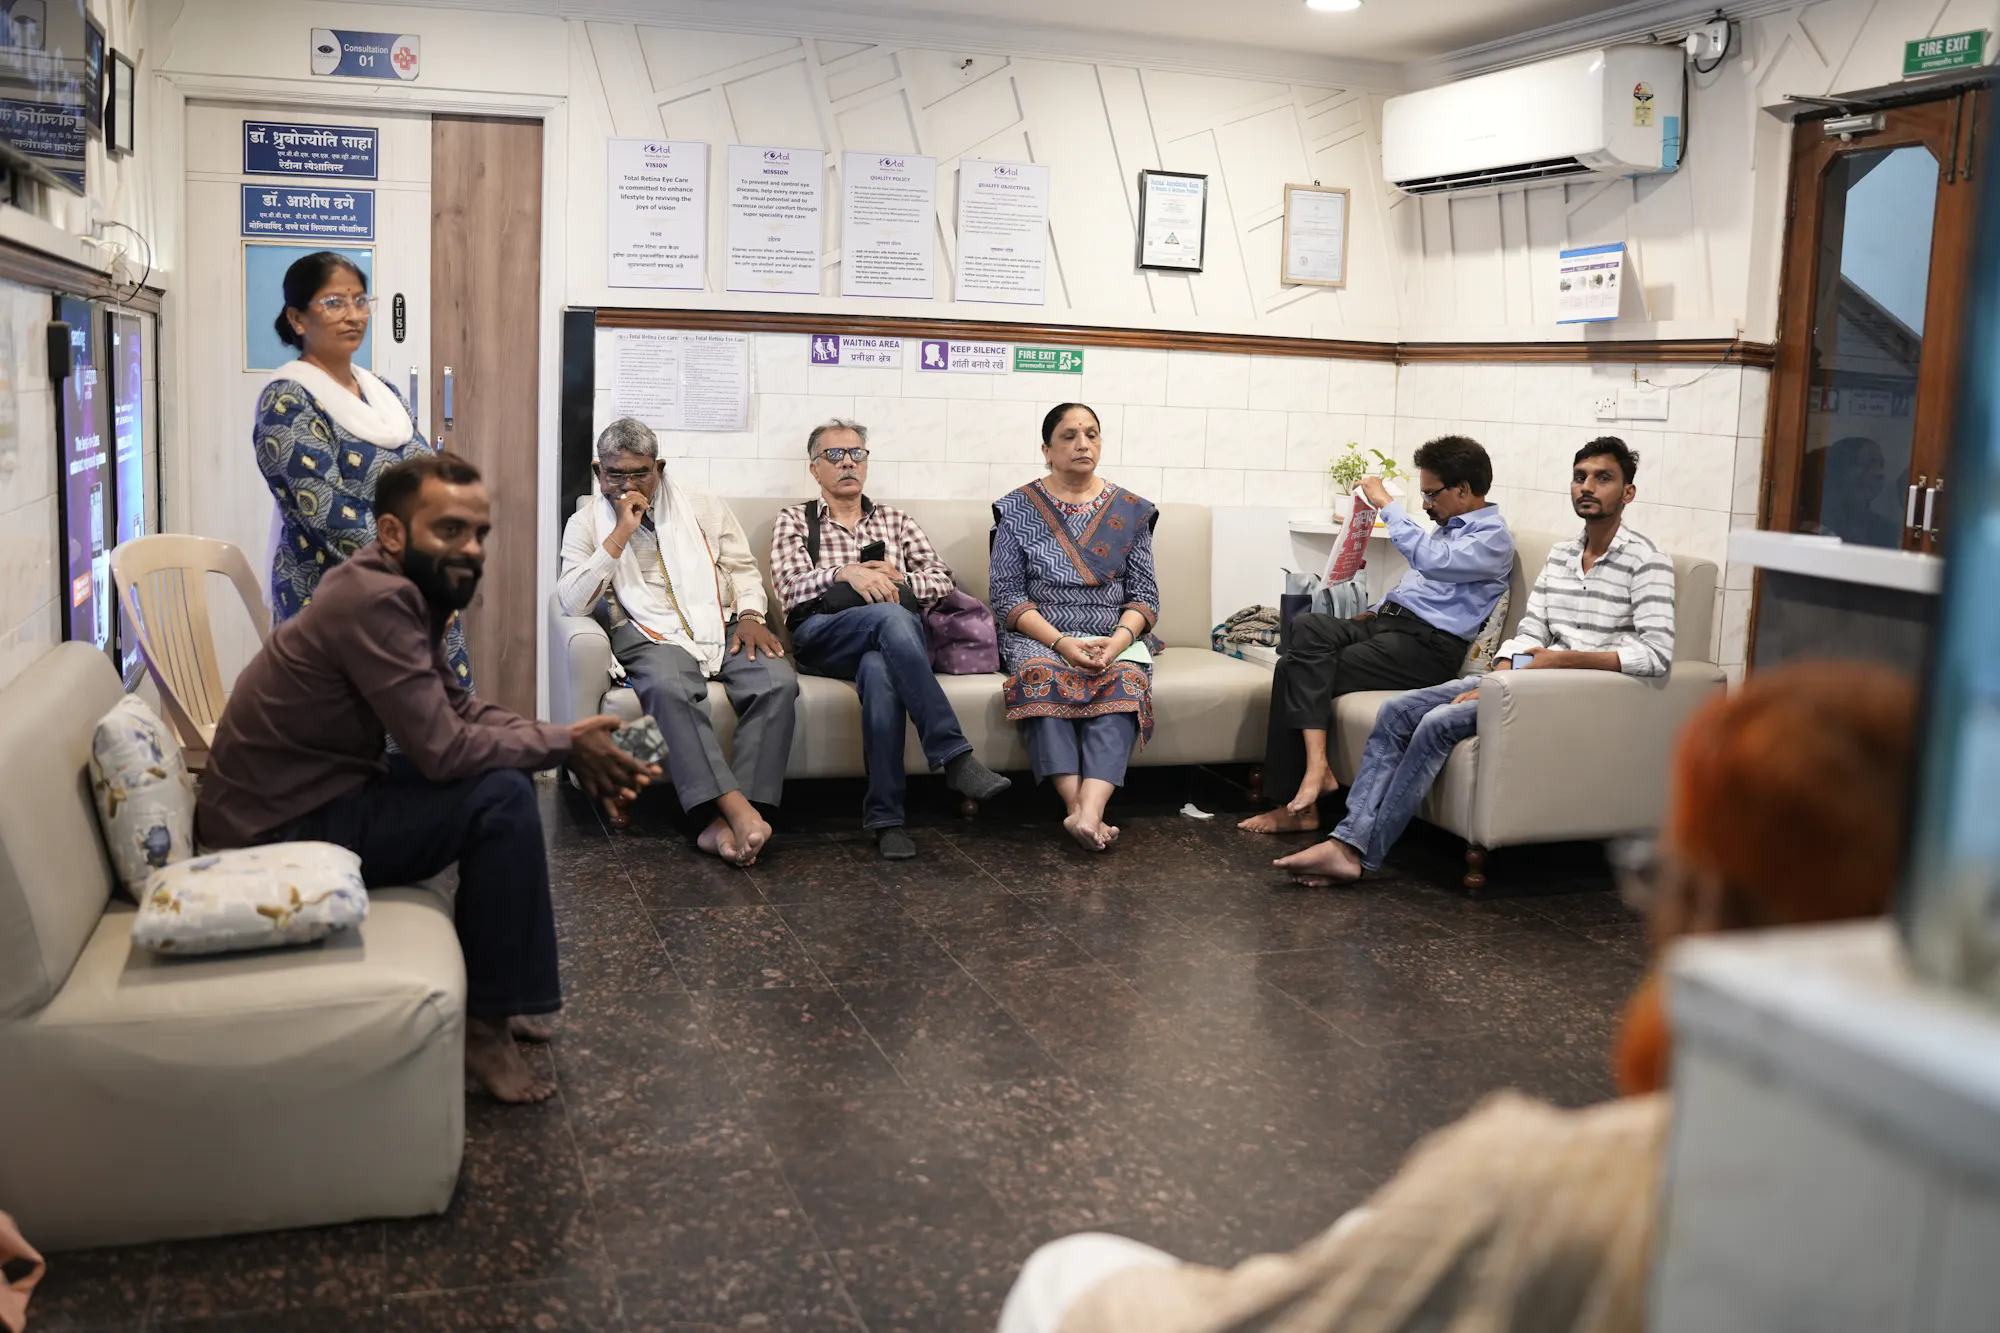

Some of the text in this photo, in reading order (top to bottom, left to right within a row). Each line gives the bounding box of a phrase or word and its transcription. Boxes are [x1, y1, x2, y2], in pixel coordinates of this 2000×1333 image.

[344, 44, 389, 55] Consultation
[1918, 36, 1971, 57] FIRE EXIT
[359, 55, 374, 67] 01
[250, 128, 268, 144] डॉ.
[340, 136, 372, 152] साहा
[278, 158, 344, 172] रेटीना स्पेशालिस्ट
[262, 191, 355, 210] डॉ. आशीष ढगे
[395, 297, 404, 339] PUSH
[843, 339, 876, 347] WAITING
[973, 346, 1006, 354] SILENCE
[1018, 350, 1056, 360] FIRE EXIT
[851, 352, 891, 363] प्रतीक्षा क्षेत्र
[952, 358, 969, 368] शांती
[971, 359, 990, 369] बनाये
